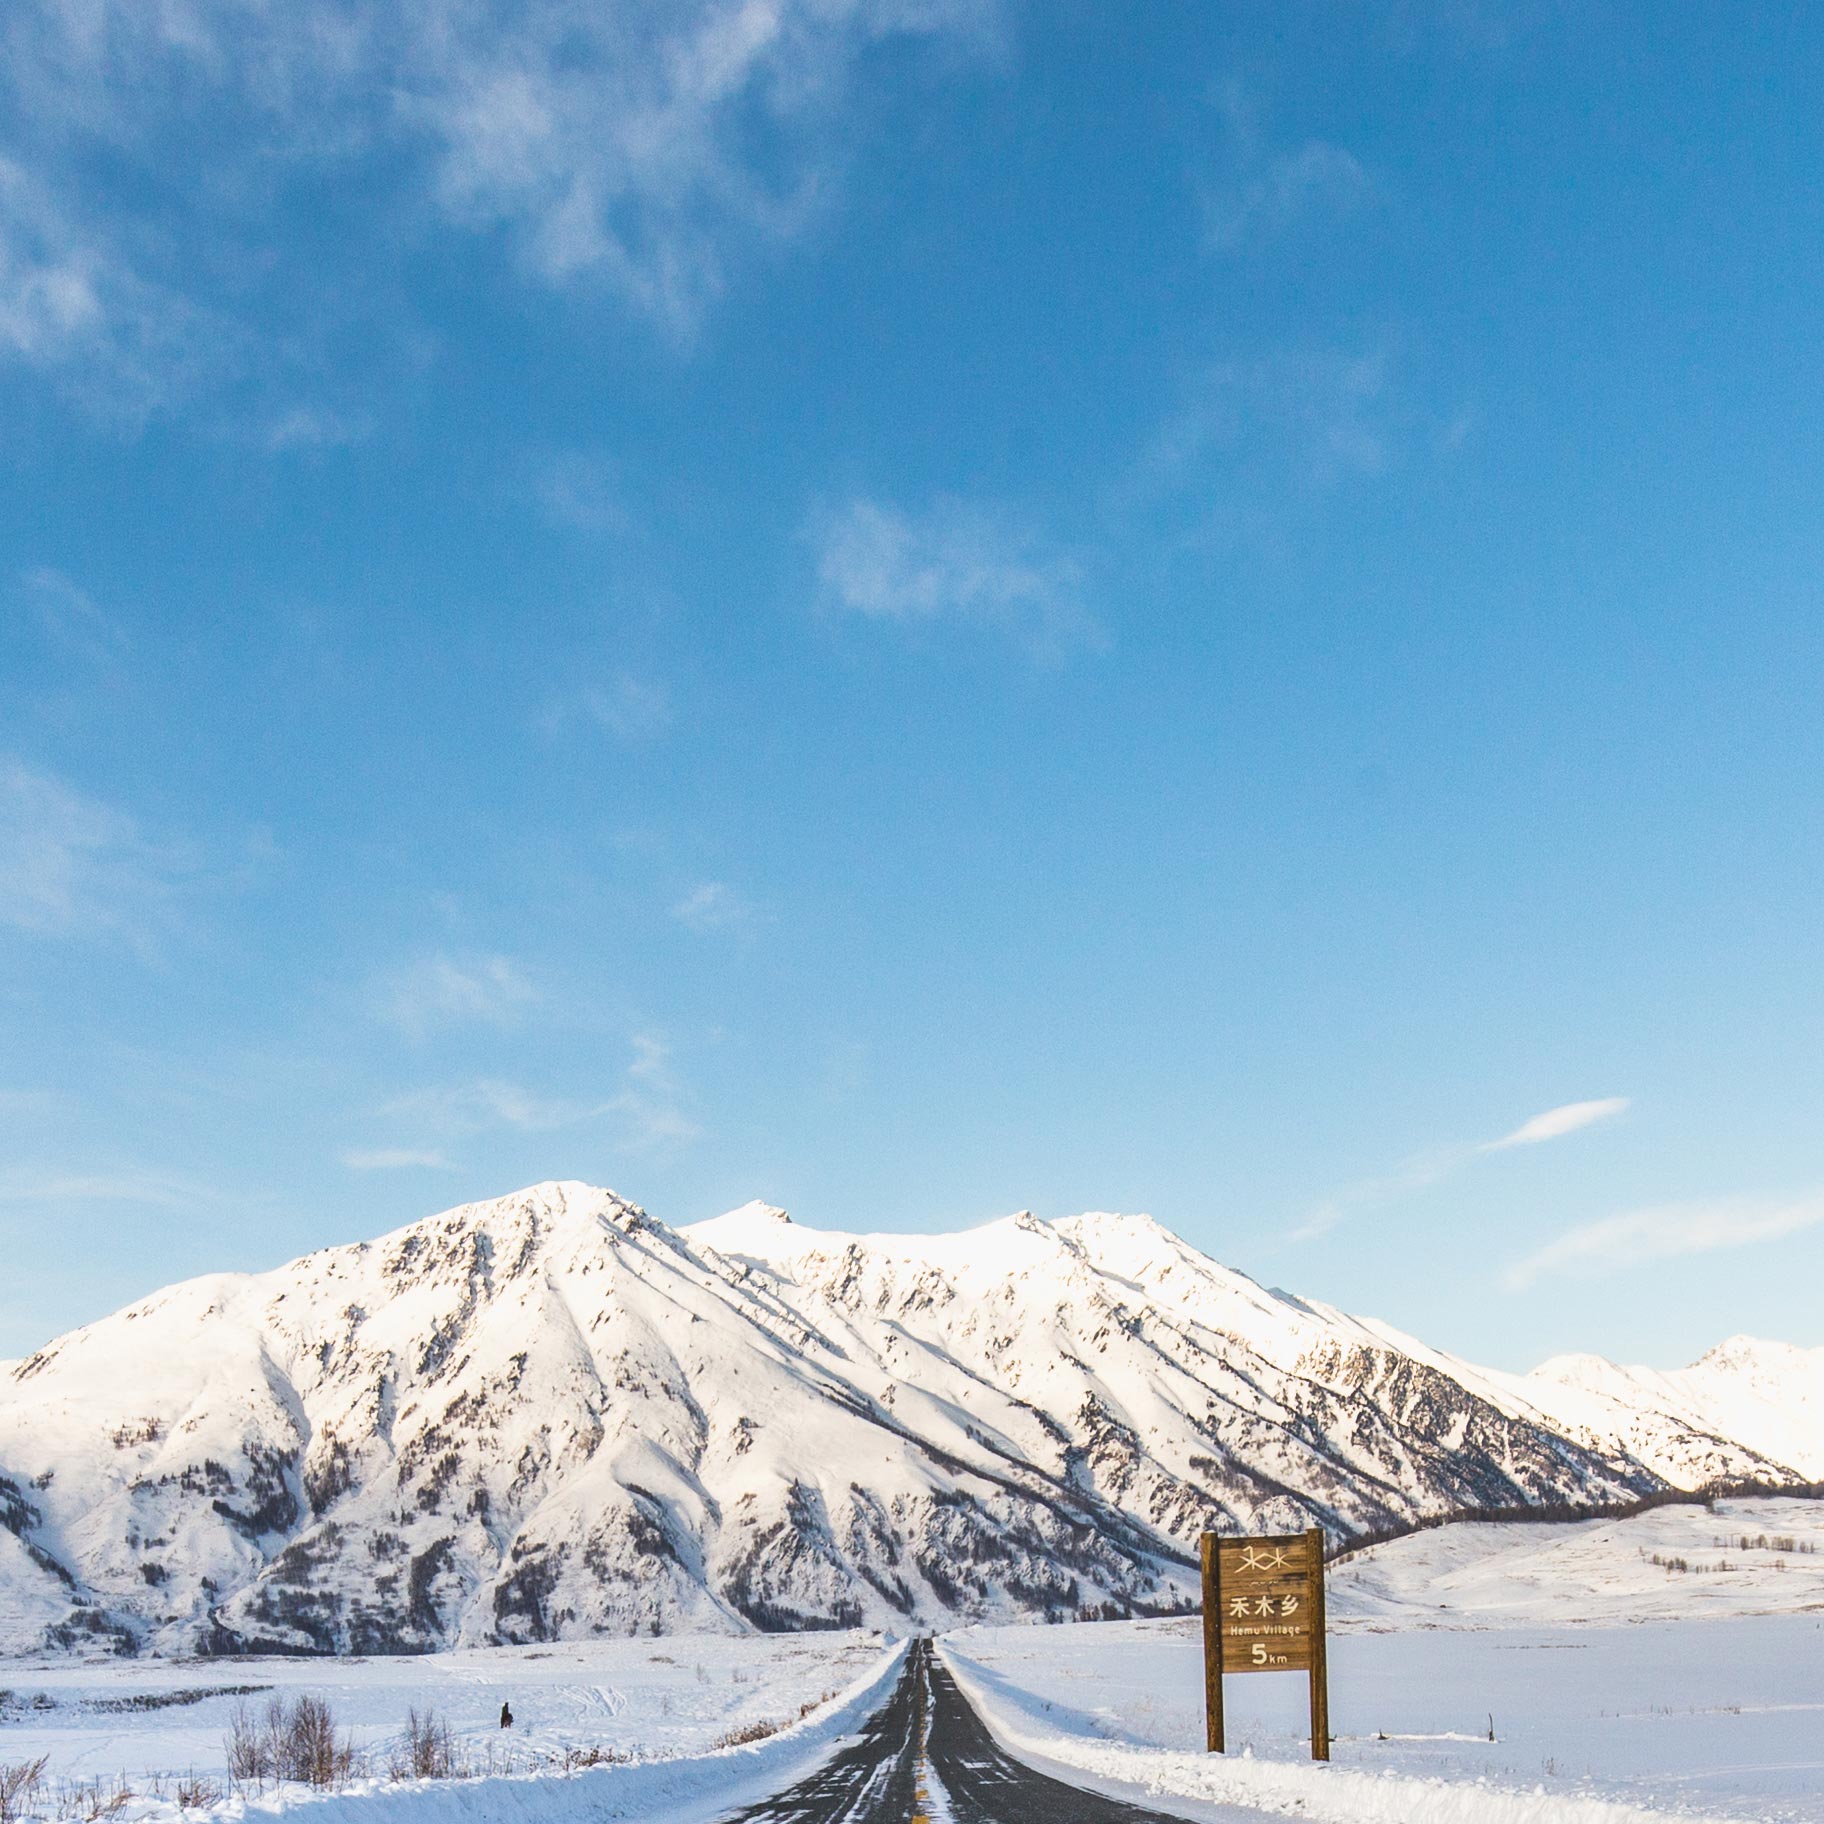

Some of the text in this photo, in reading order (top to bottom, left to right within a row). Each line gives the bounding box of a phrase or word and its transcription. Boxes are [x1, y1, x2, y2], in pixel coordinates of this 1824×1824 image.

[1229, 1594, 1299, 1618] 禾木乡
[1230, 1625, 1301, 1637] Hemu Village
